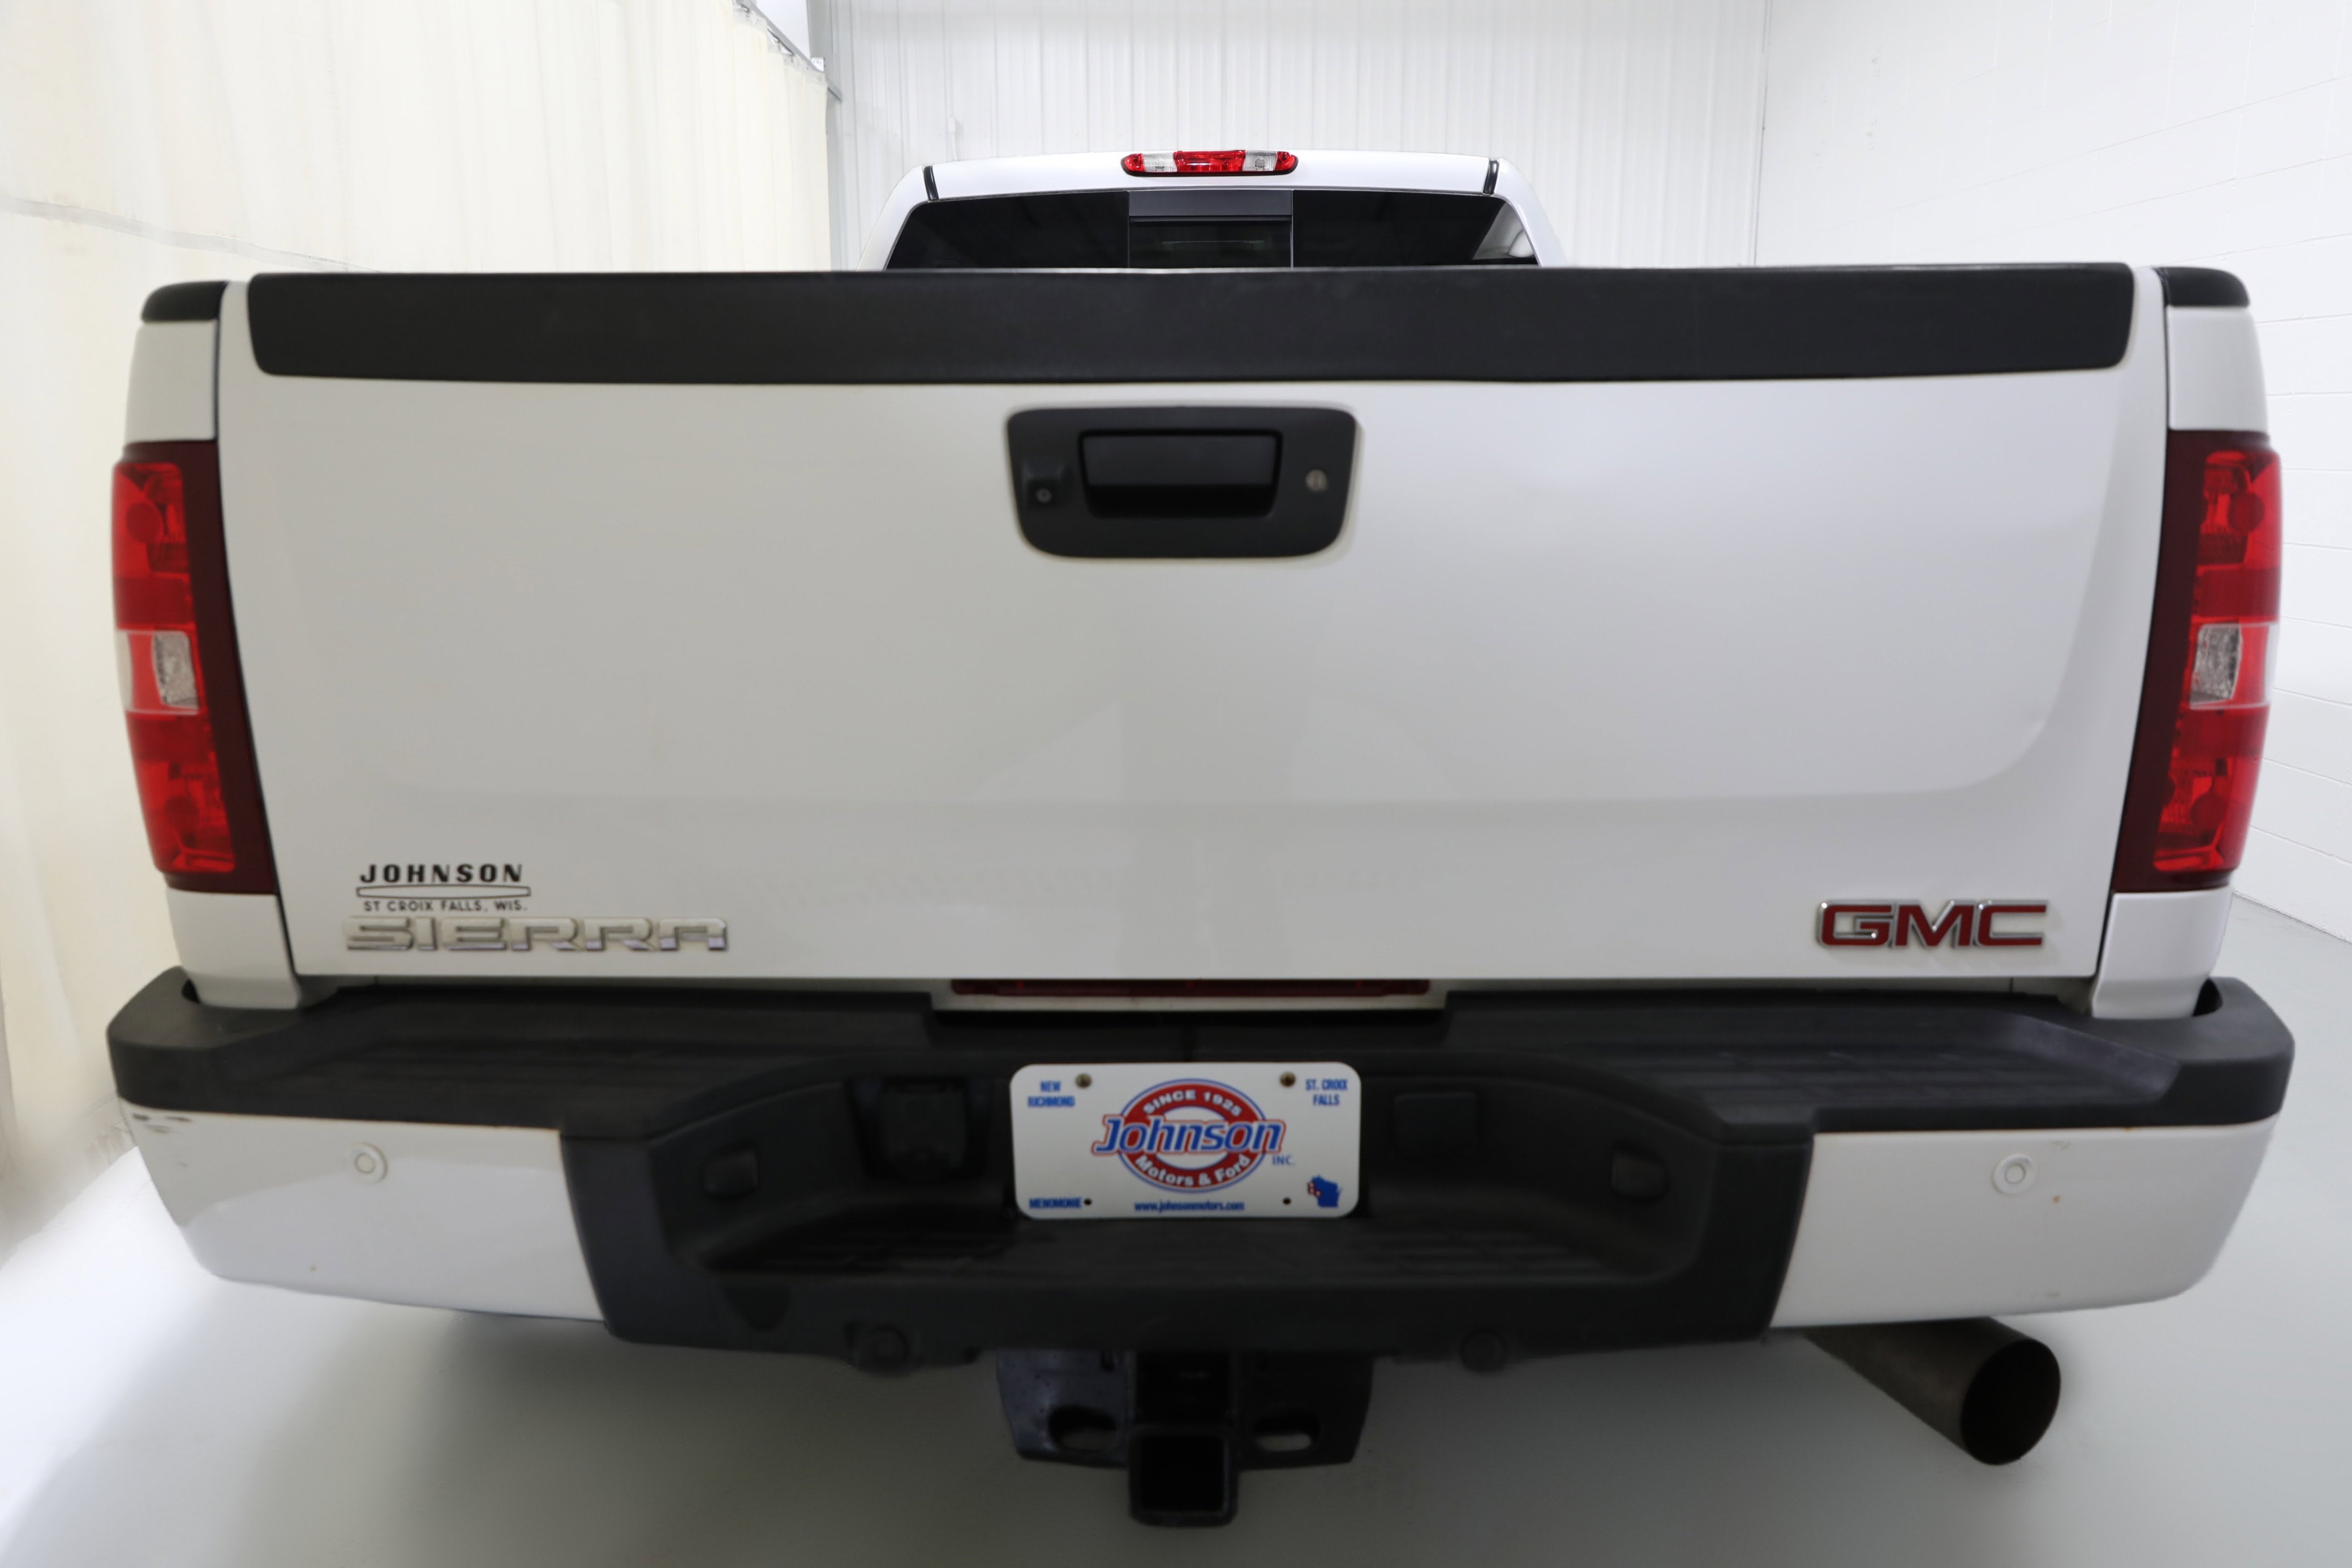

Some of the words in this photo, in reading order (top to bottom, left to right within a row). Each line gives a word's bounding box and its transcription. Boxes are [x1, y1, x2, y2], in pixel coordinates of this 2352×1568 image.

[360, 864, 522, 883] JOHNSON
[363, 901, 384, 912] ST
[386, 901, 434, 912] CROIX
[494, 900, 528, 912] WIS.
[1816, 899, 2048, 949] GMC
[344, 916, 728, 952] SIERRA
[1040, 1081, 1061, 1092] NEW
[1322, 1079, 1347, 1090] CROIX
[1028, 1096, 1076, 1107] RICHMOND
[1143, 1089, 1196, 1115] SINCE
[1313, 1094, 1340, 1105] FALLS
[1094, 1116, 1285, 1154] Johnson
[1272, 1154, 1296, 1166] INC.
[1135, 1154, 1194, 1186] Motors
[1198, 1172, 1212, 1187] &
[1215, 1153, 1251, 1182] Ford
